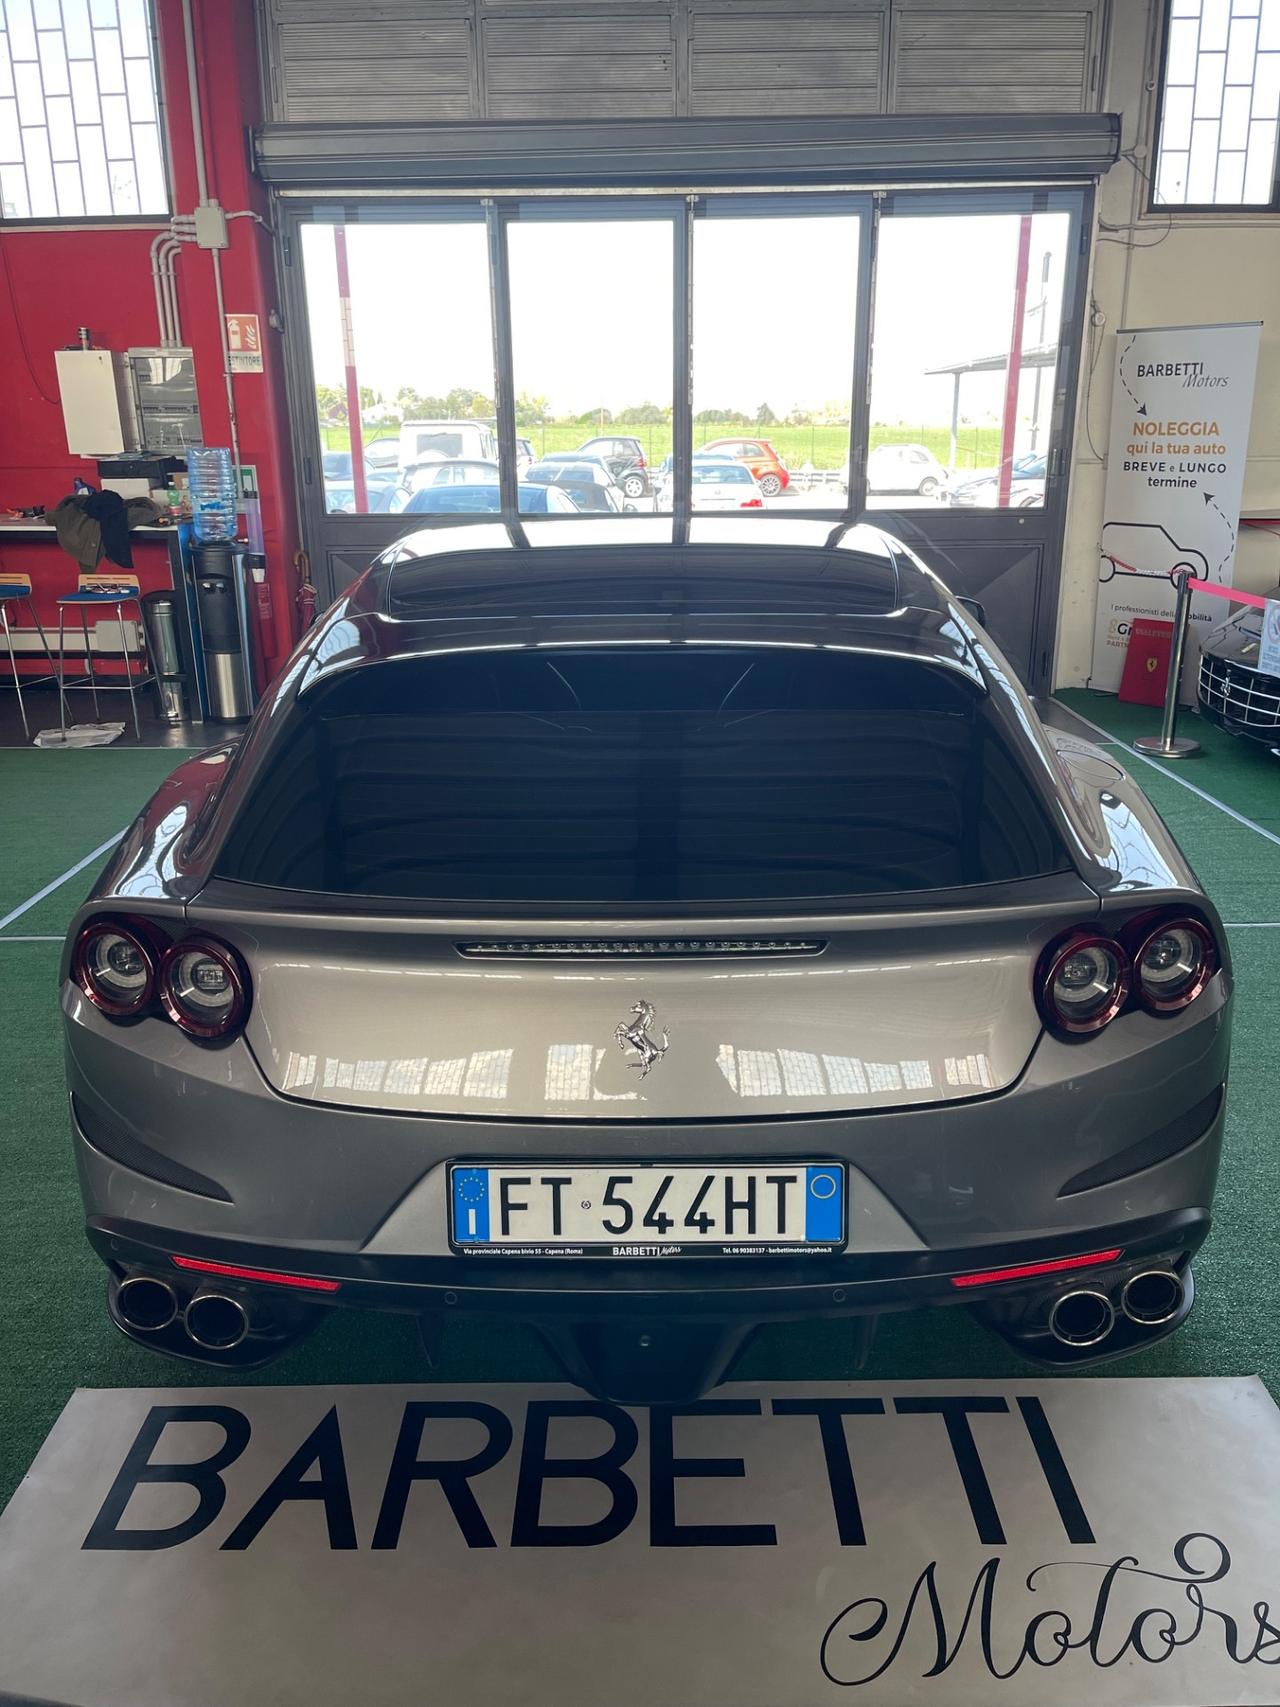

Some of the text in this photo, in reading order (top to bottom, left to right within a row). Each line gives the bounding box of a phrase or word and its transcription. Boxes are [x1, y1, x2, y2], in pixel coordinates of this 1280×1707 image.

[1137, 362, 1204, 377] BARBETTI
[1182, 374, 1229, 388] Motors
[1133, 421, 1220, 436] NOLEGGIA
[1127, 442, 1226, 456] qui la tua auto
[1123, 461, 1227, 473] BREVE e LUNGO
[1147, 476, 1198, 488] termine
[1114, 604, 1159, 616] professionisti
[1160, 609, 1175, 618] dell
[1187, 612, 1213, 623] obilità
[499, 1174, 798, 1236] FT 544HT
[468, 1208, 477, 1235] I
[472, 1248, 501, 1256] provinciale
[501, 1248, 521, 1256] Capena
[544, 1248, 564, 1256] Capena
[564, 1248, 583, 1256] (Roma)
[612, 1246, 660, 1256] BARBETTI
[80, 1396, 1097, 1551] BARBETTI
[820, 1532, 1280, 1687] Motors
